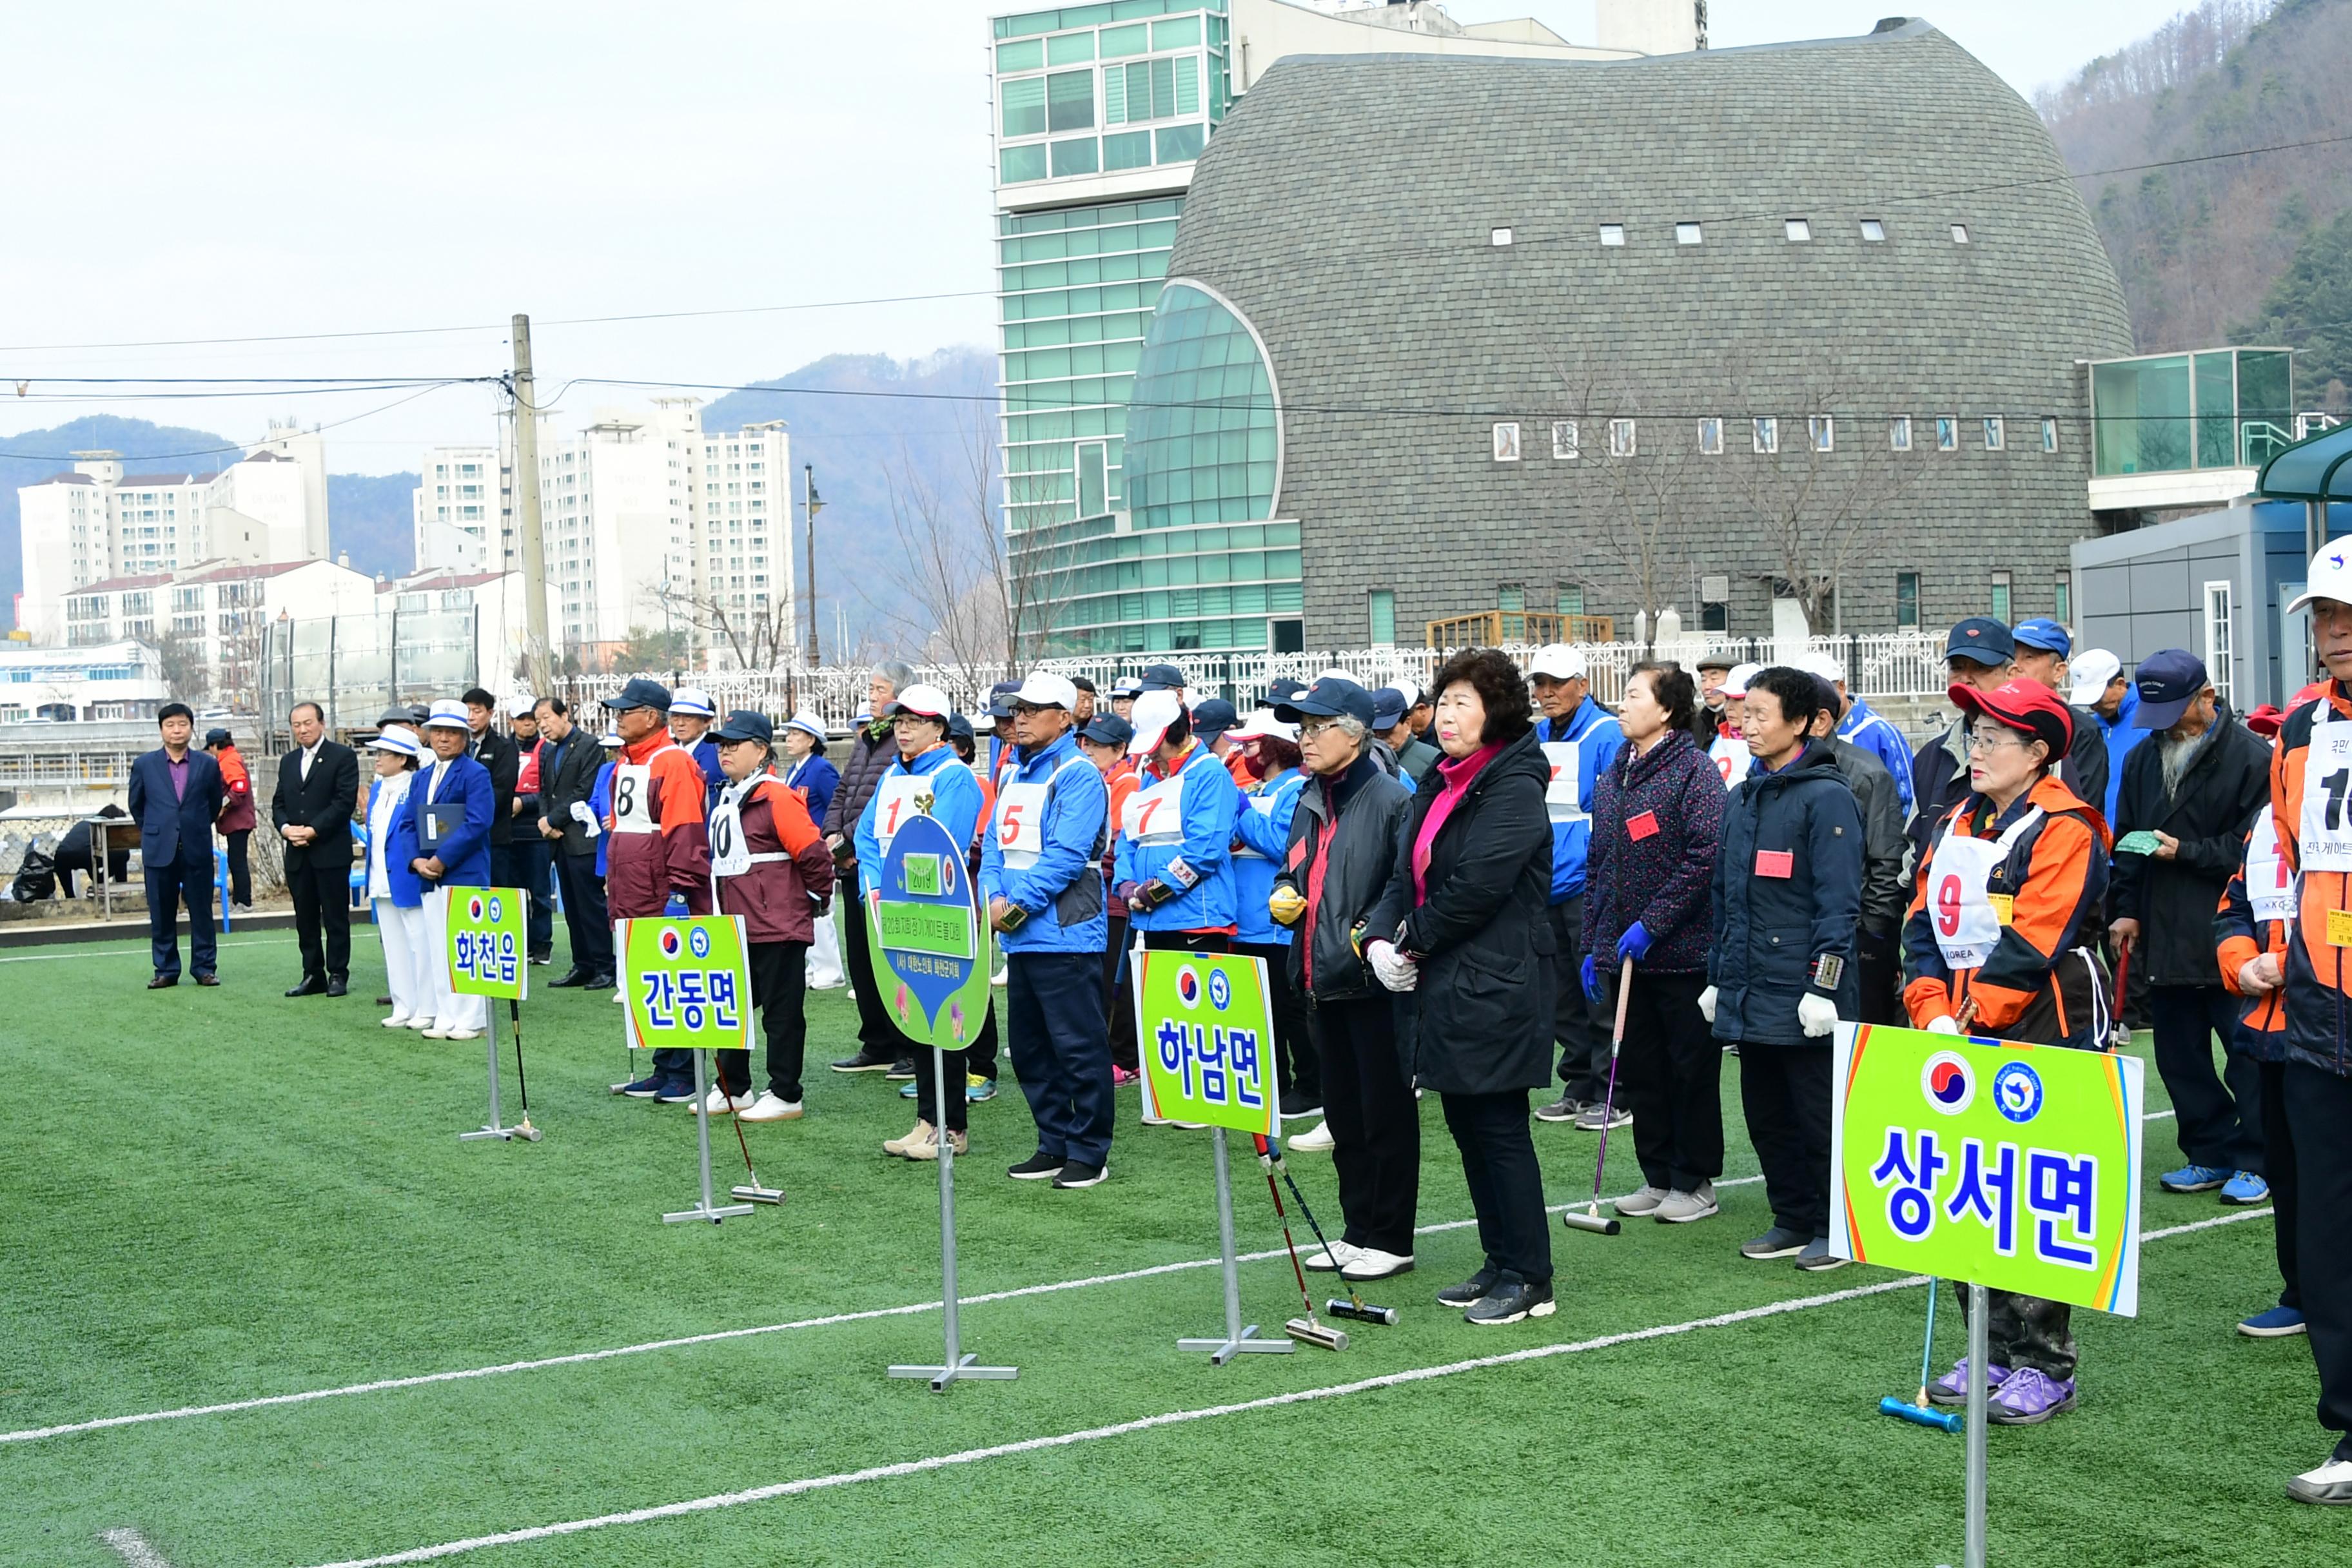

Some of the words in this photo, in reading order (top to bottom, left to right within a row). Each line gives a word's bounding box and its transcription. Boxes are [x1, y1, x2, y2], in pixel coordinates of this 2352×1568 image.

[618, 776, 636, 817] 8
[887, 797, 902, 834] 1
[2320, 768, 2352, 830] 1
[712, 814, 732, 859] 10
[1001, 805, 1024, 845] 5
[912, 866, 931, 888] 2019
[1937, 874, 1962, 937] 9
[457, 934, 517, 981] 화천읍
[643, 972, 738, 1030] 간동면
[1157, 1021, 1262, 1105] 하남면
[1873, 1132, 2093, 1266] 상서면
